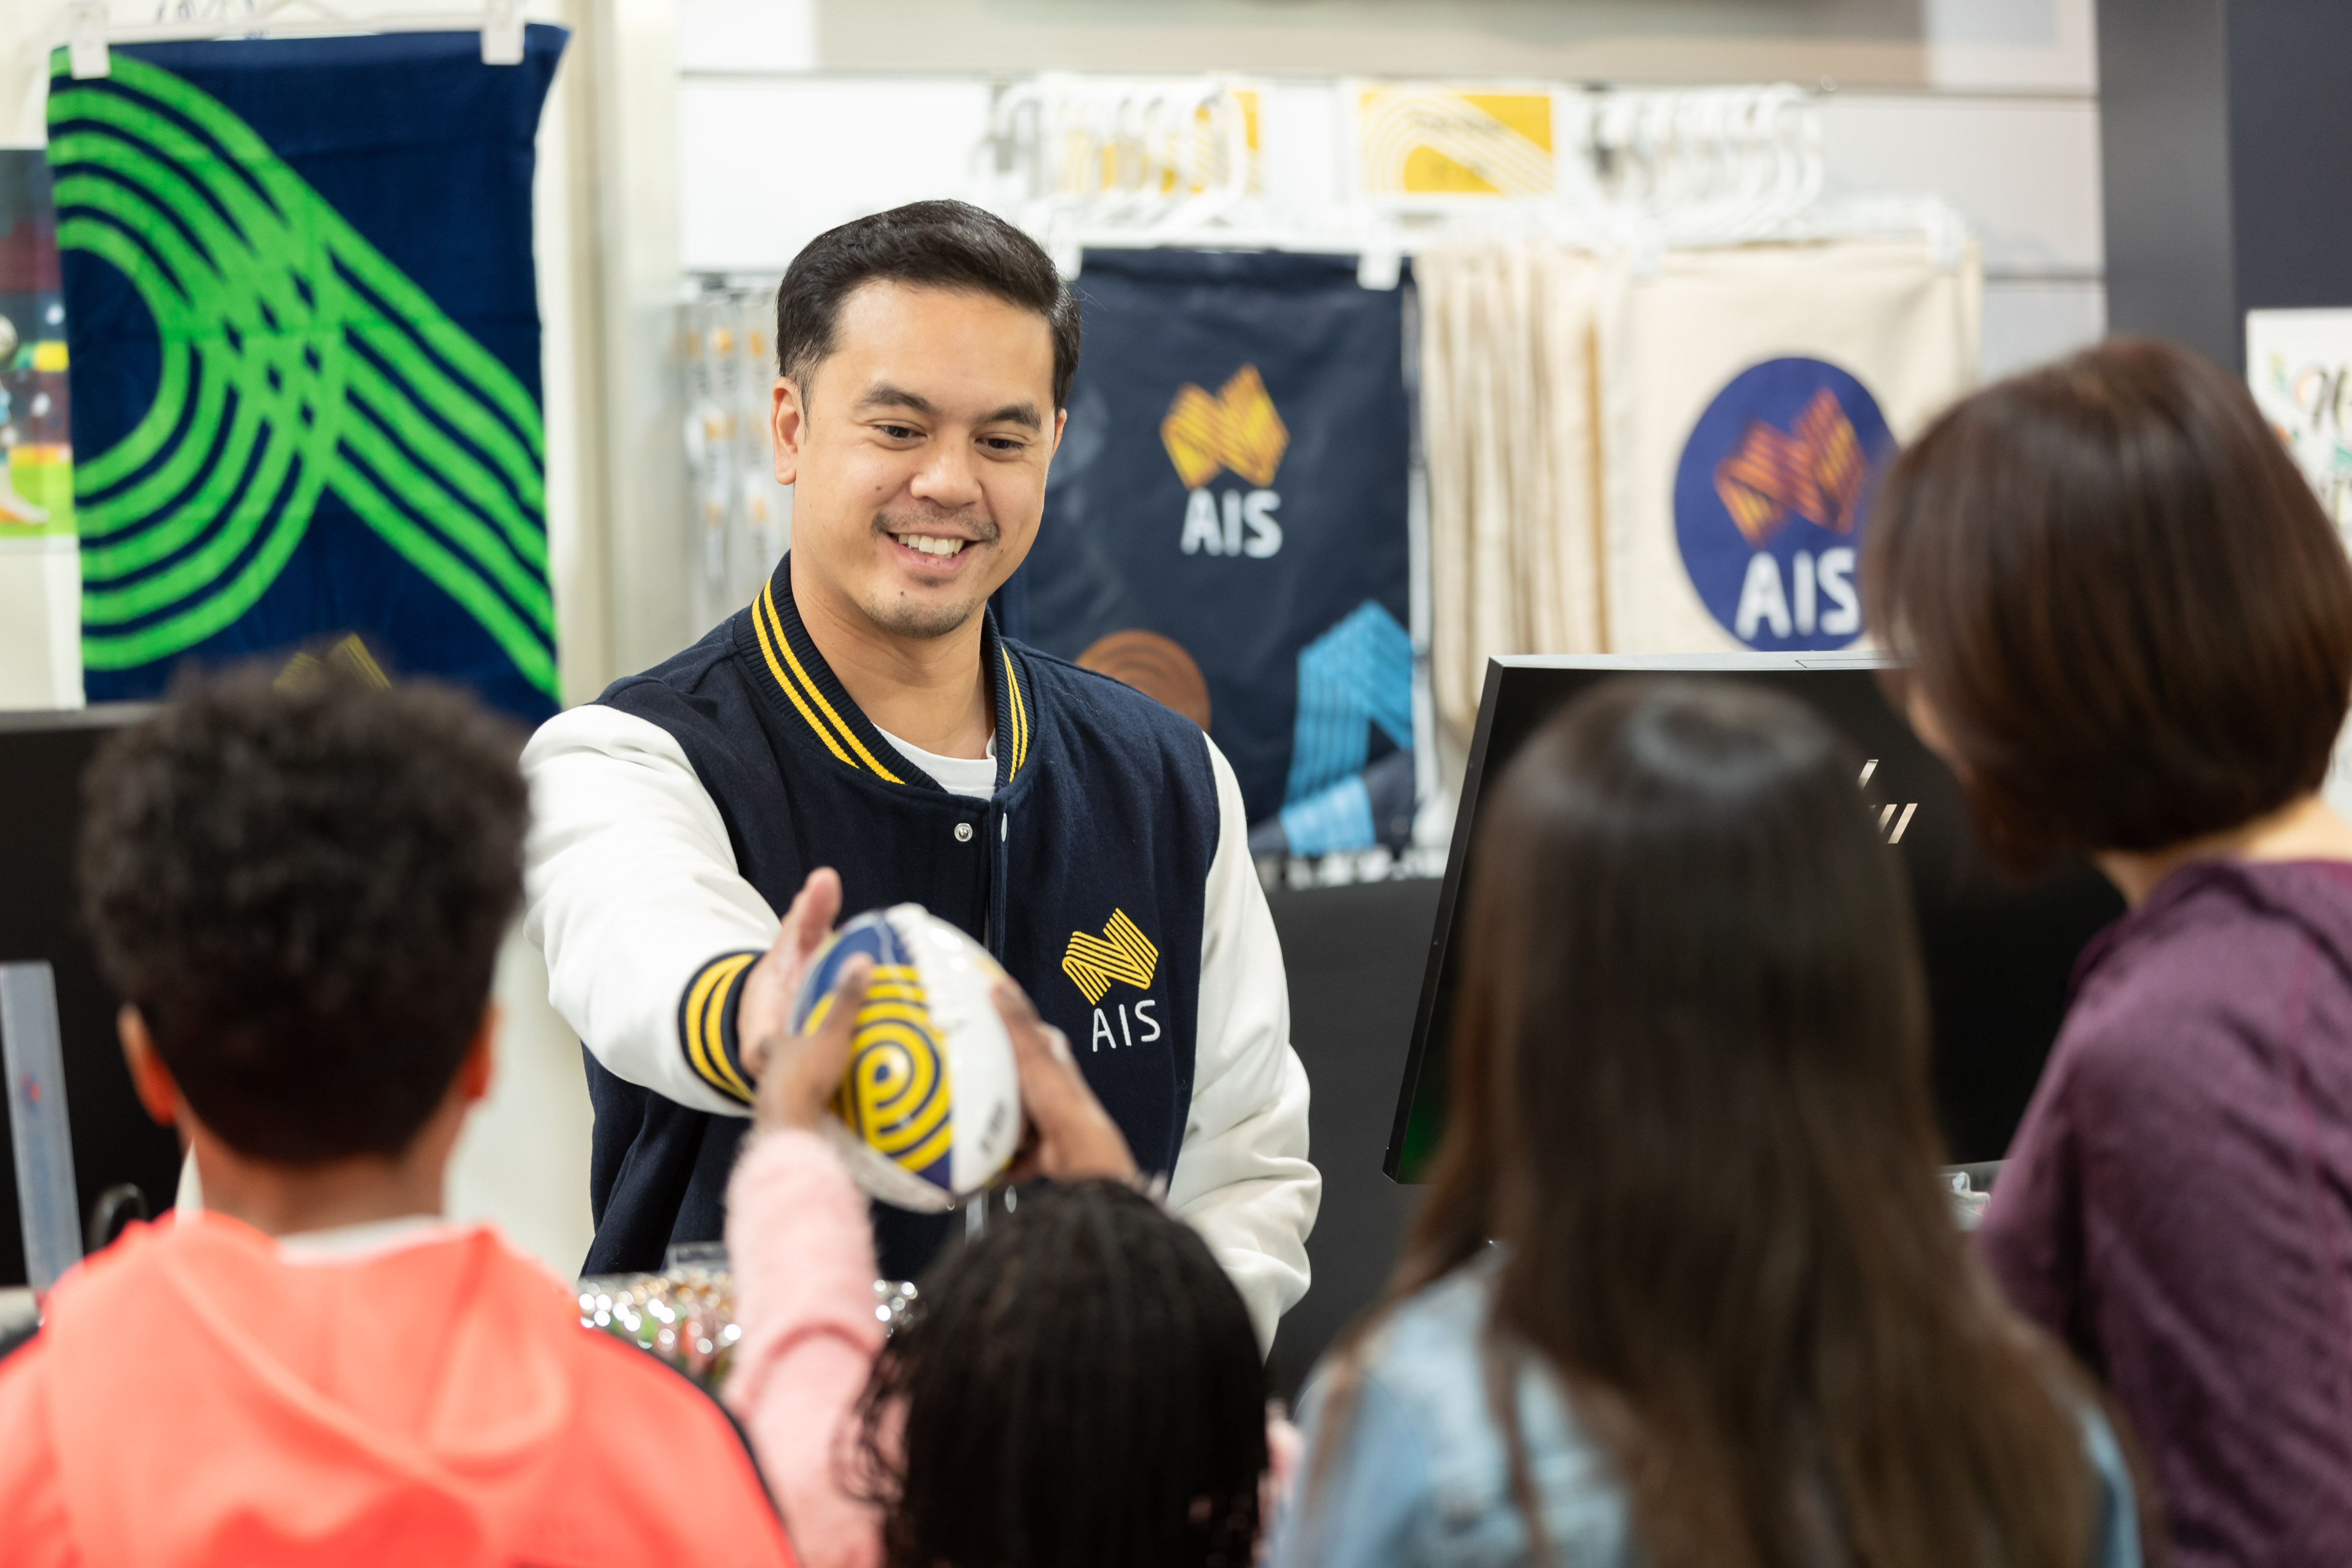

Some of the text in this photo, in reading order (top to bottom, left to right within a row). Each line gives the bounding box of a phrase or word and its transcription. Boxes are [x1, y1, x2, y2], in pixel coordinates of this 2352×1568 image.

[1180, 487, 1283, 558] AIS
[1735, 546, 1860, 641] AIS
[1092, 999, 1161, 1052] AIS
